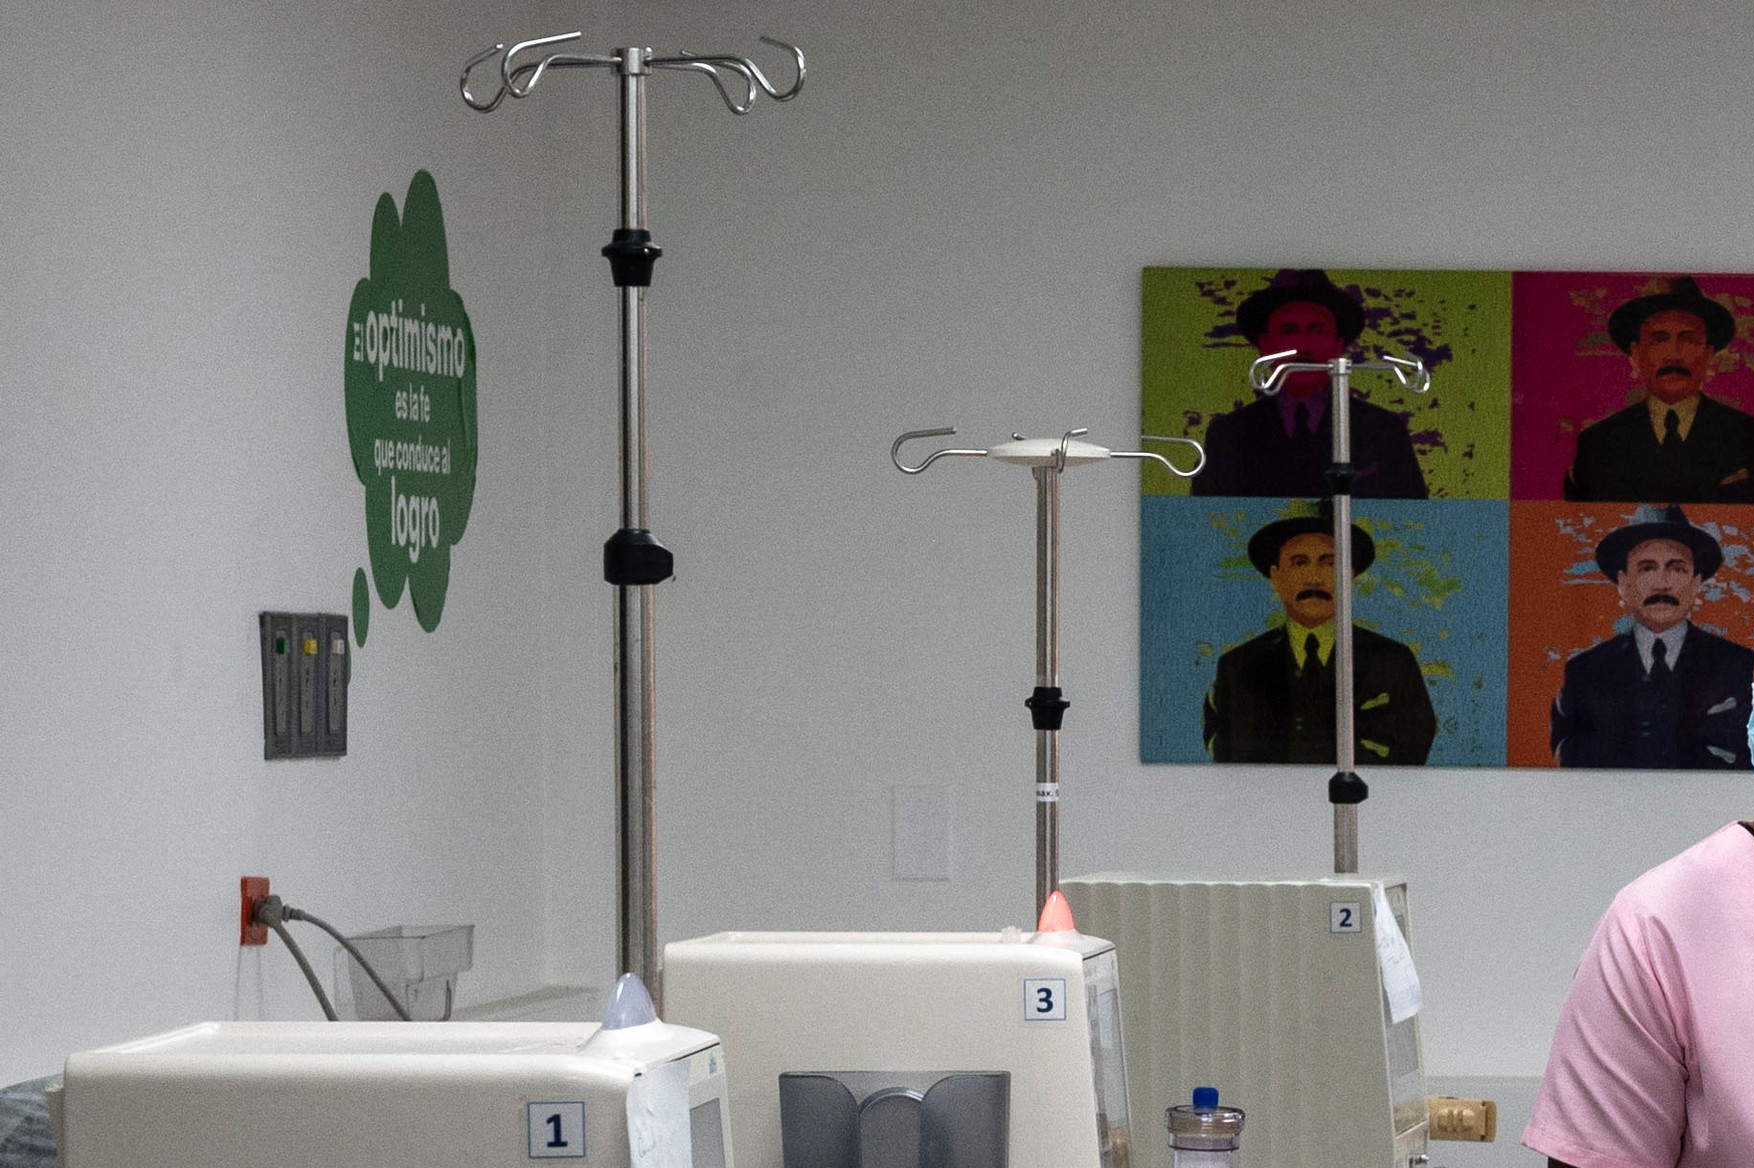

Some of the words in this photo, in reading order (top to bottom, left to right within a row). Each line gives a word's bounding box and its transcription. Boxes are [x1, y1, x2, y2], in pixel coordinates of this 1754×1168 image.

[365, 299, 466, 382] optimismo
[395, 390, 408, 420] es
[409, 383, 419, 421] la
[420, 385, 431, 422] fe
[374, 438, 395, 477] que
[396, 434, 440, 474] conduce
[441, 438, 451, 475] al
[391, 475, 440, 563] logro
[1339, 907, 1353, 928] 2
[1036, 987, 1054, 1013] 3
[545, 1113, 569, 1149] 1
